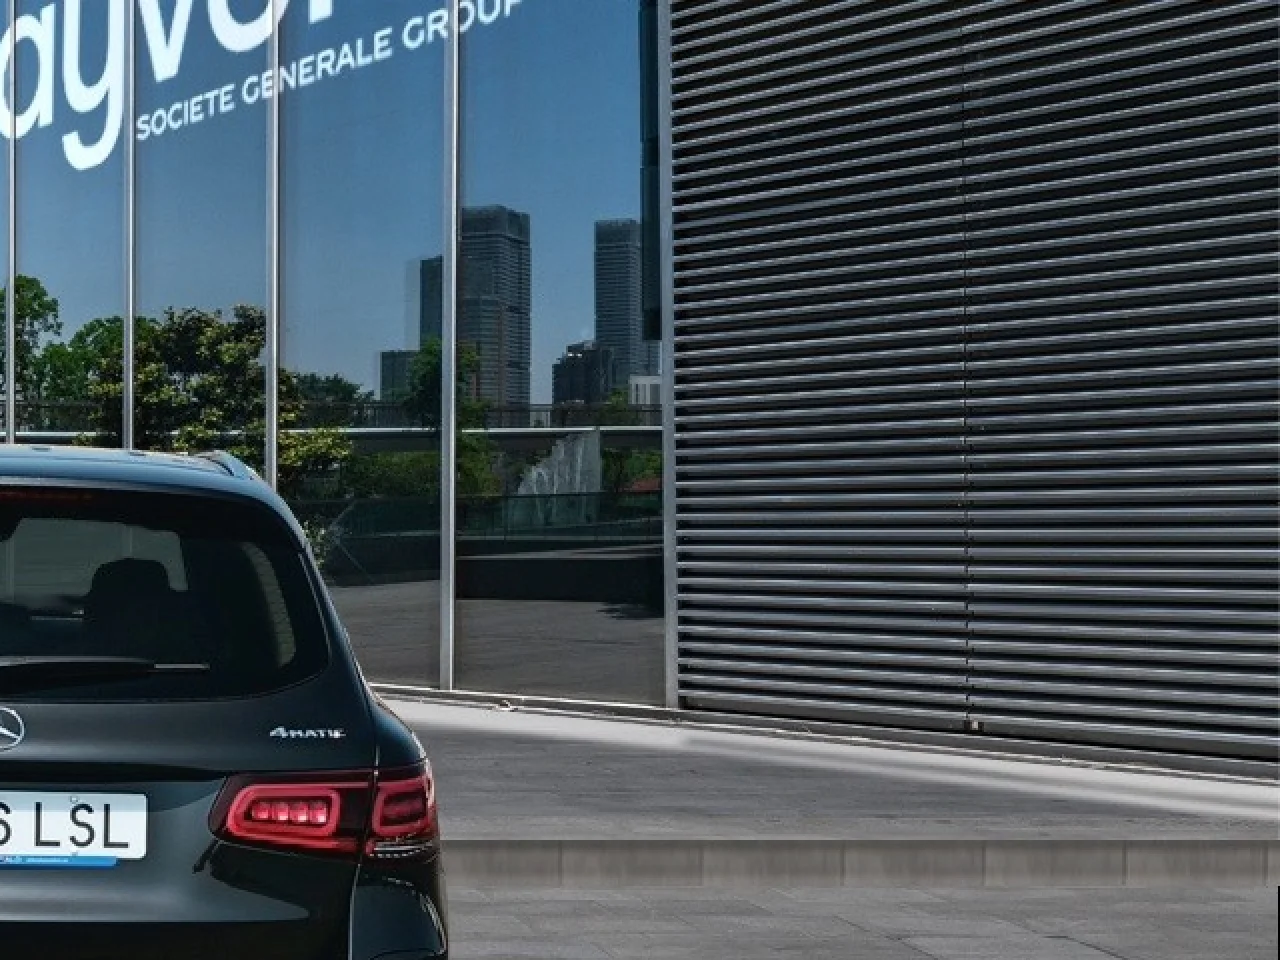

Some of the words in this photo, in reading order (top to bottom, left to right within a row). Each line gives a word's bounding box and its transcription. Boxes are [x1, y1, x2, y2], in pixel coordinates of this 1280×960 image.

[136, 86, 235, 140] SOCIETE
[241, 28, 393, 105] GENERALE
[34, 802, 129, 848] LSL
